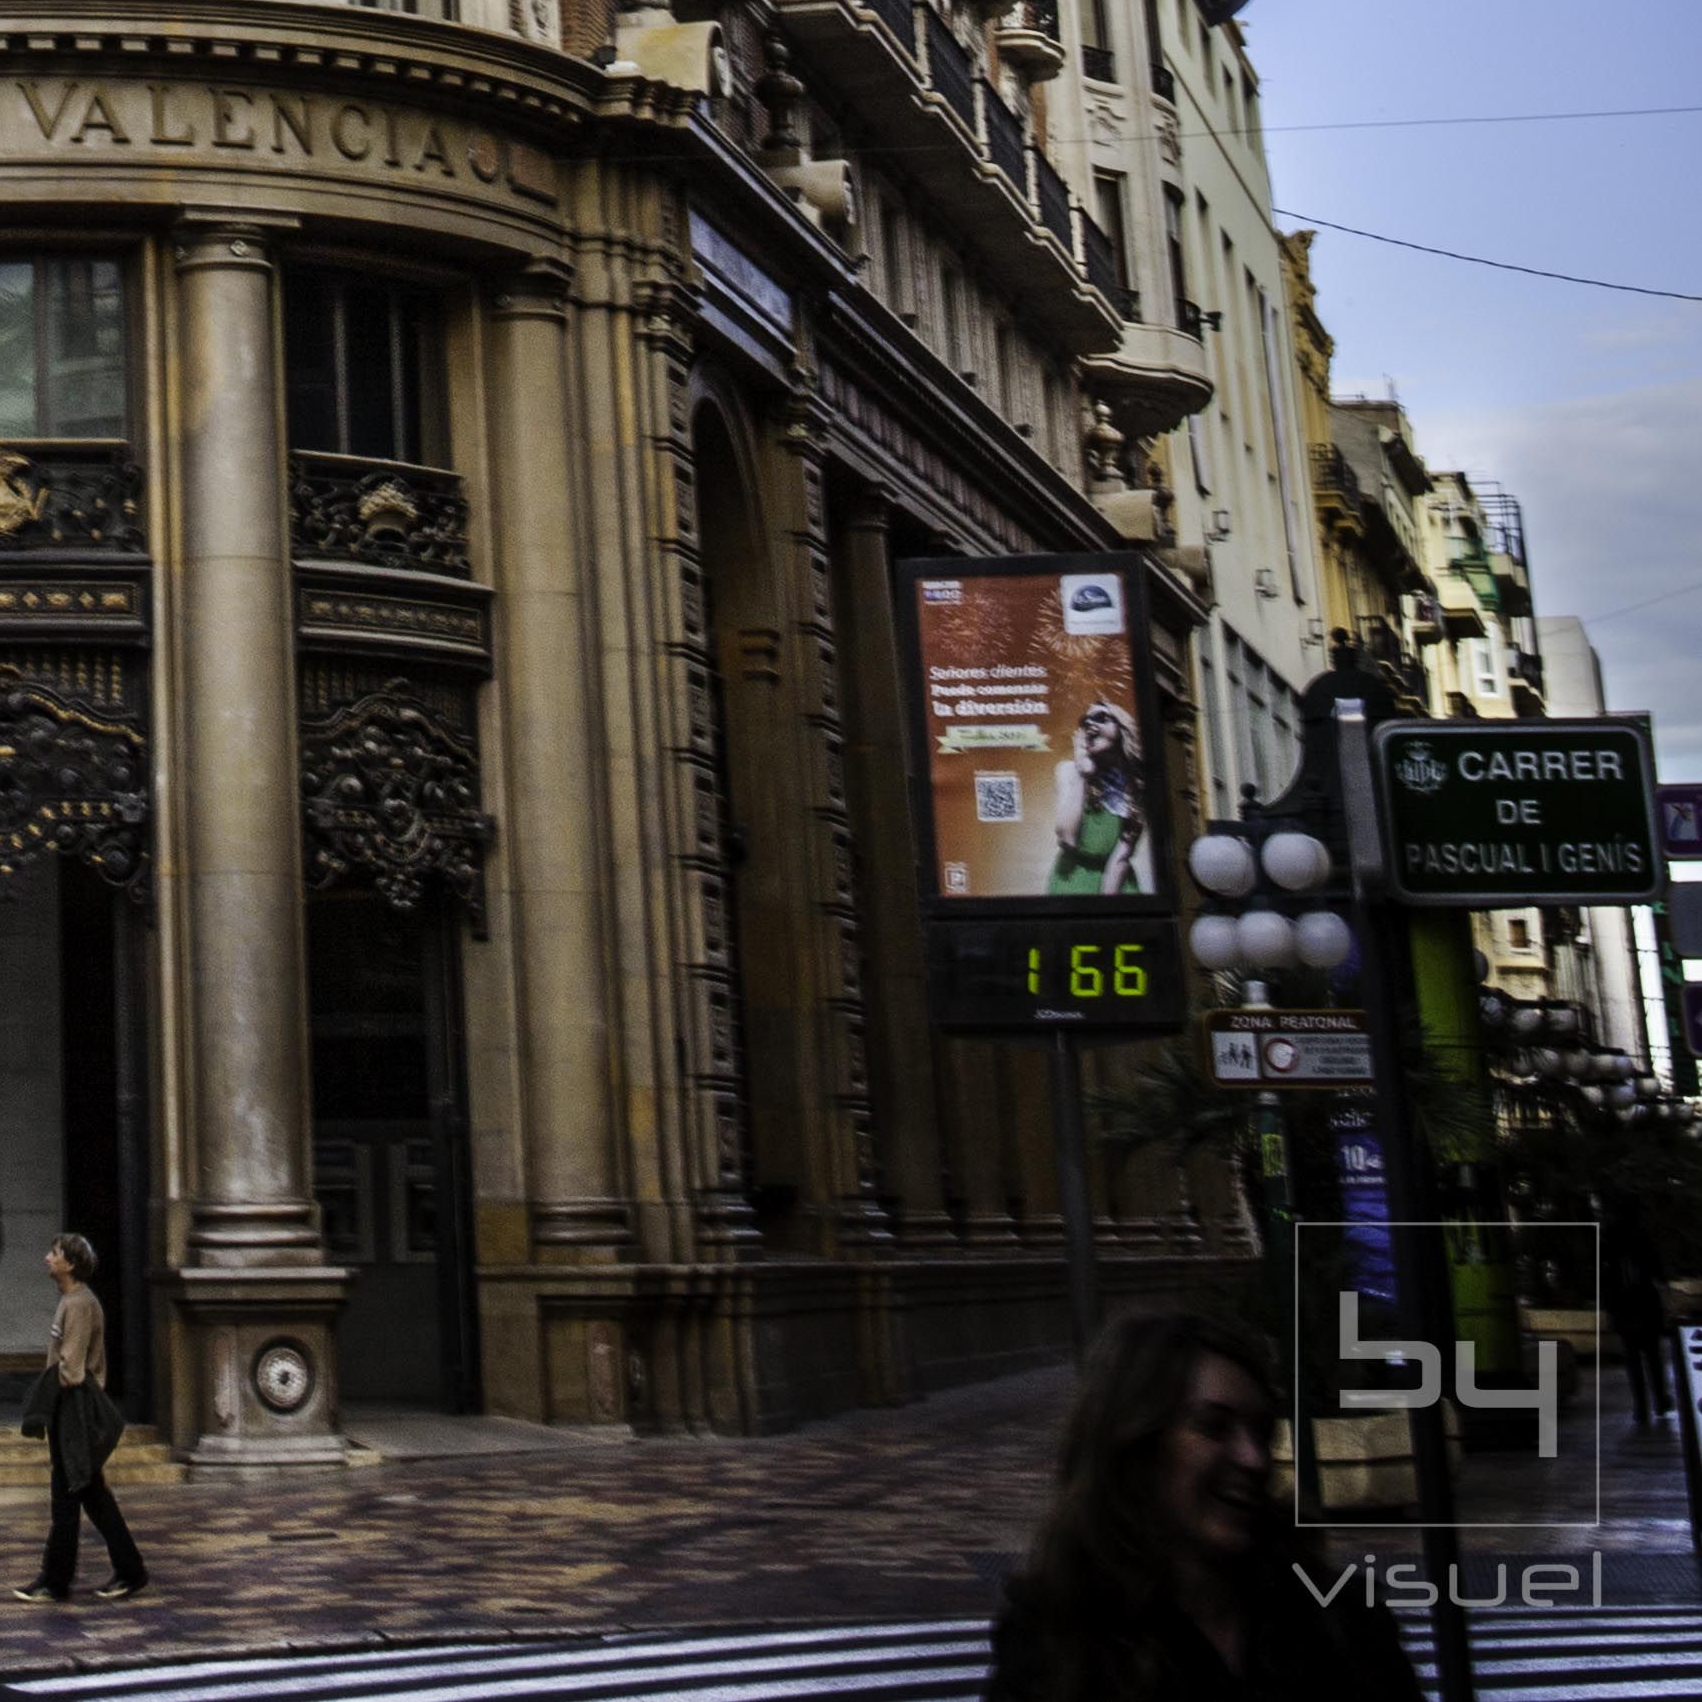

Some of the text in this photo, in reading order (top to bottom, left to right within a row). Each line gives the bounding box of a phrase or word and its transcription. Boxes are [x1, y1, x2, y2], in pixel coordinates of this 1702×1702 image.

[16, 79, 457, 179] VALENCIA
[1456, 750, 1626, 781] CARRER
[1495, 798, 1542, 825] DE
[1404, 843, 1535, 874] PASCUAL
[1557, 833, 1644, 873] GENÍS
[1229, 1015, 1358, 1029] ZONA PEATONAL
